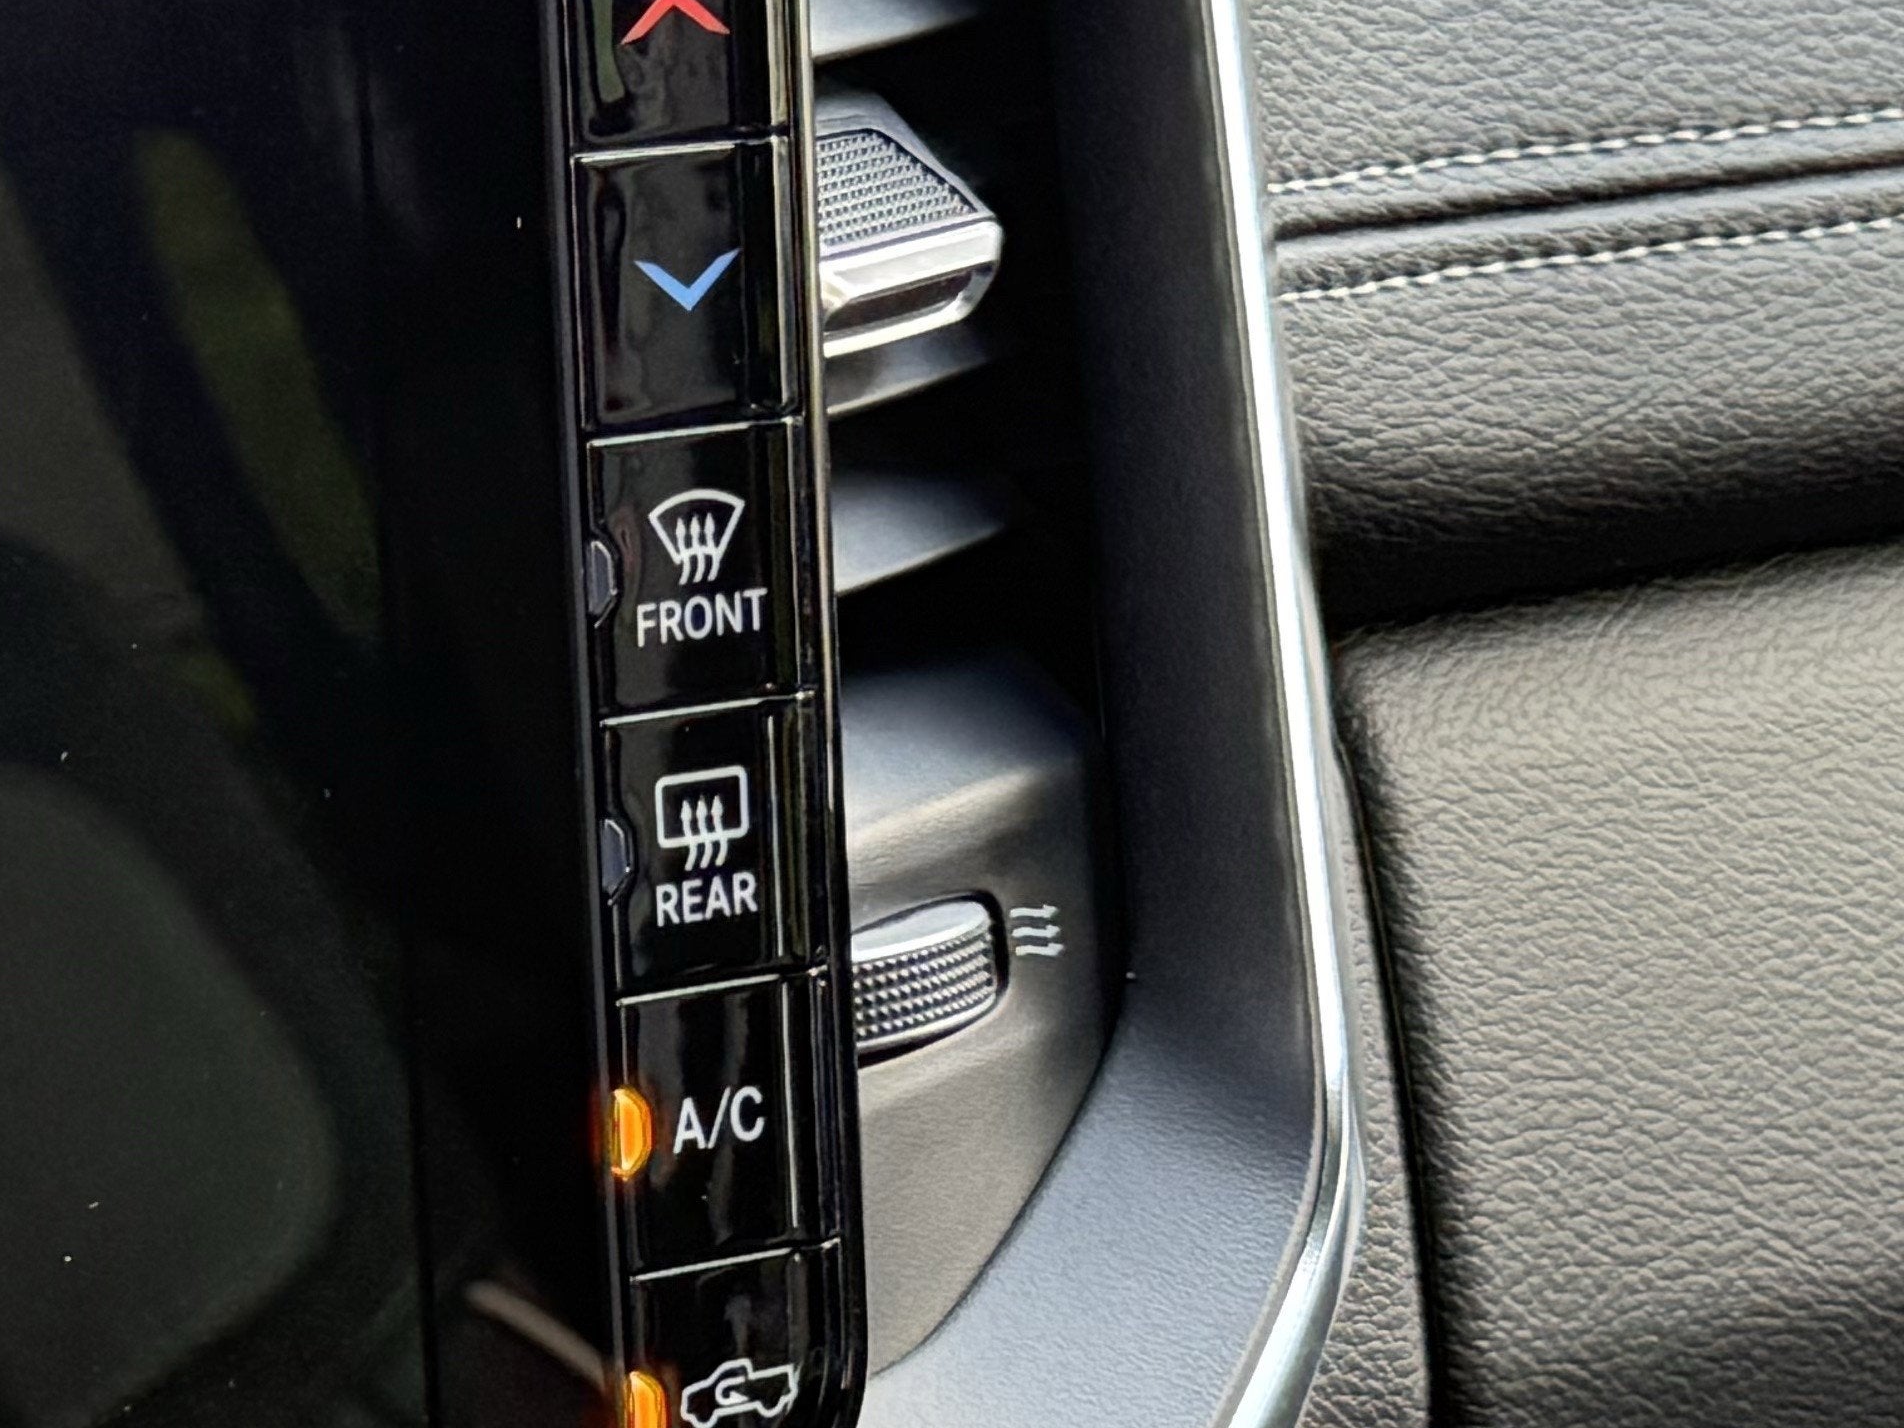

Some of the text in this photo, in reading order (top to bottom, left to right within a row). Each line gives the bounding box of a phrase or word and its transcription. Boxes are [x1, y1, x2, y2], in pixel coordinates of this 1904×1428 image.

[636, 588, 768, 648] FRONT
[655, 871, 758, 926] REAR
[673, 1085, 765, 1154] A/C
